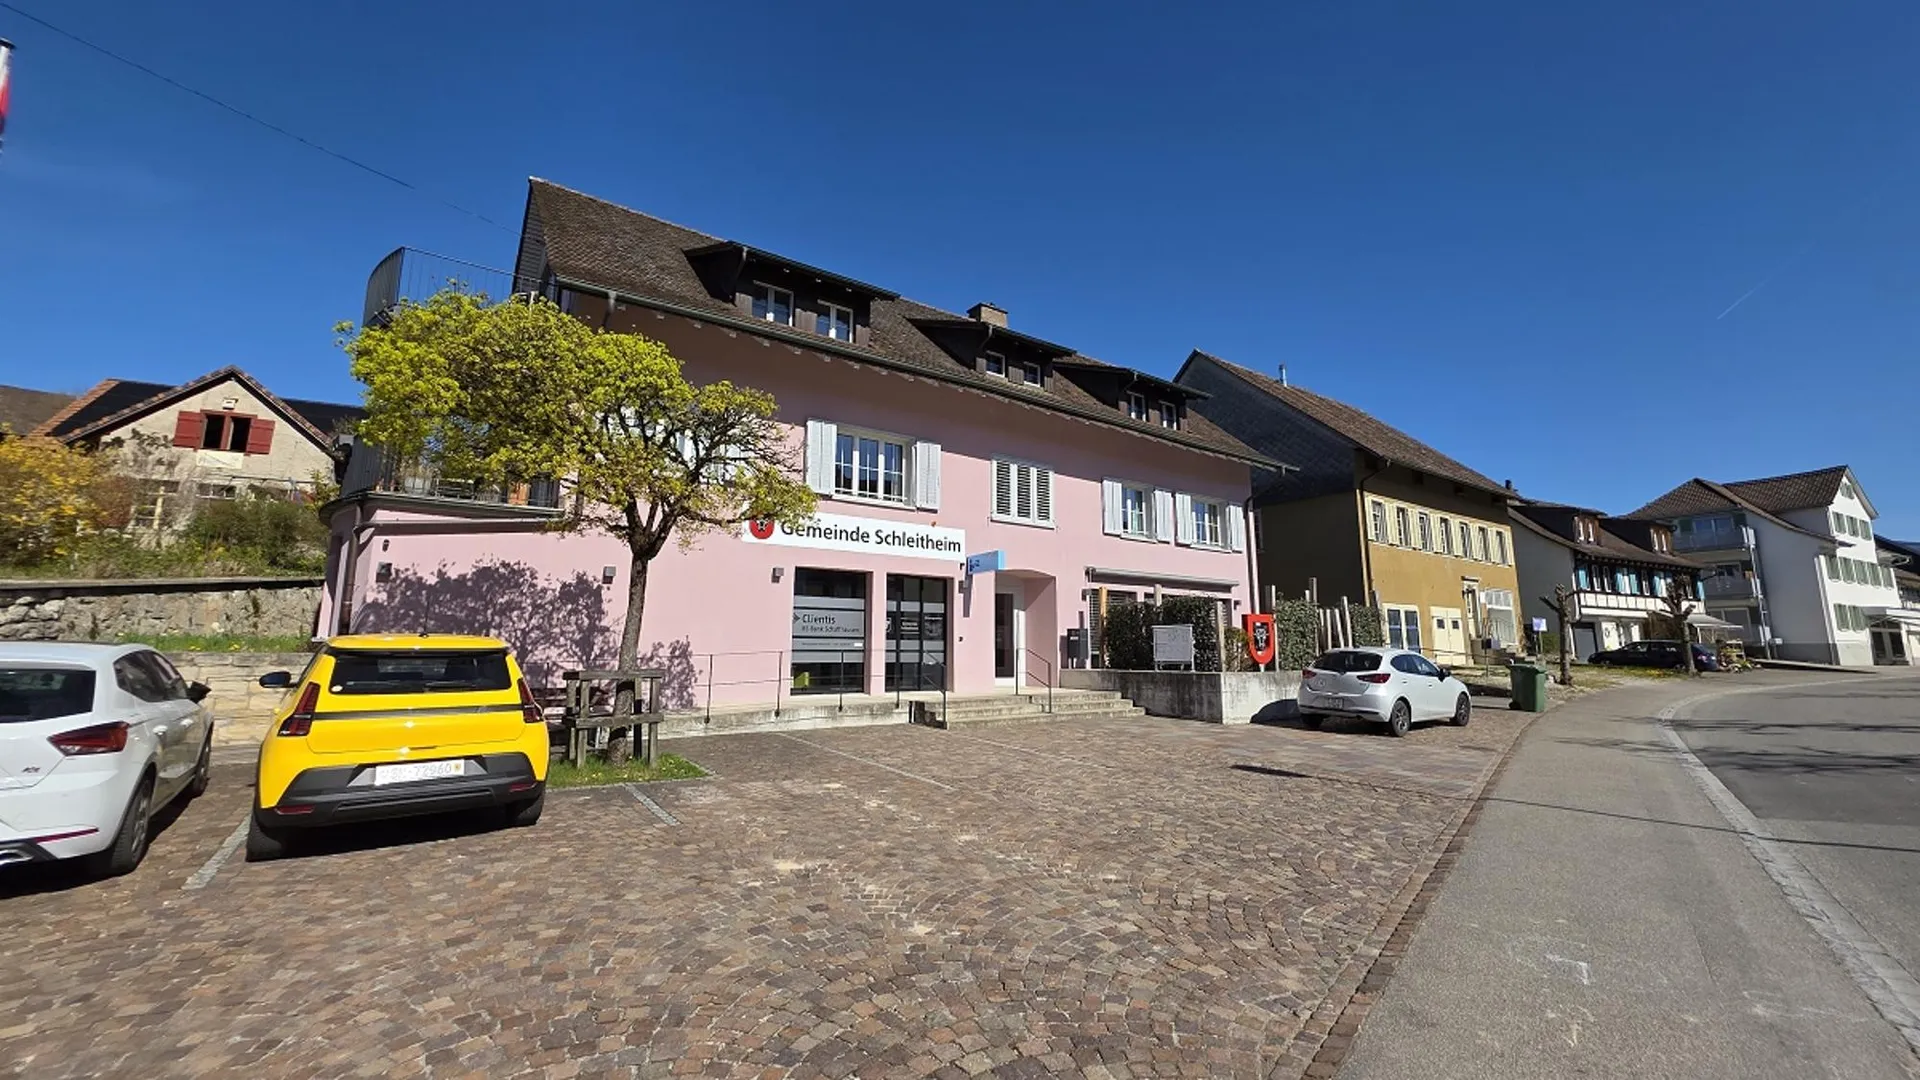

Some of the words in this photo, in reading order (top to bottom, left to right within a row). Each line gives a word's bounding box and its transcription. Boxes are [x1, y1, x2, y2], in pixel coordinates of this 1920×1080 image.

[780, 519, 870, 544] Gemeinde
[875, 529, 961, 553] Schleitheim
[802, 613, 836, 625] Clientis
